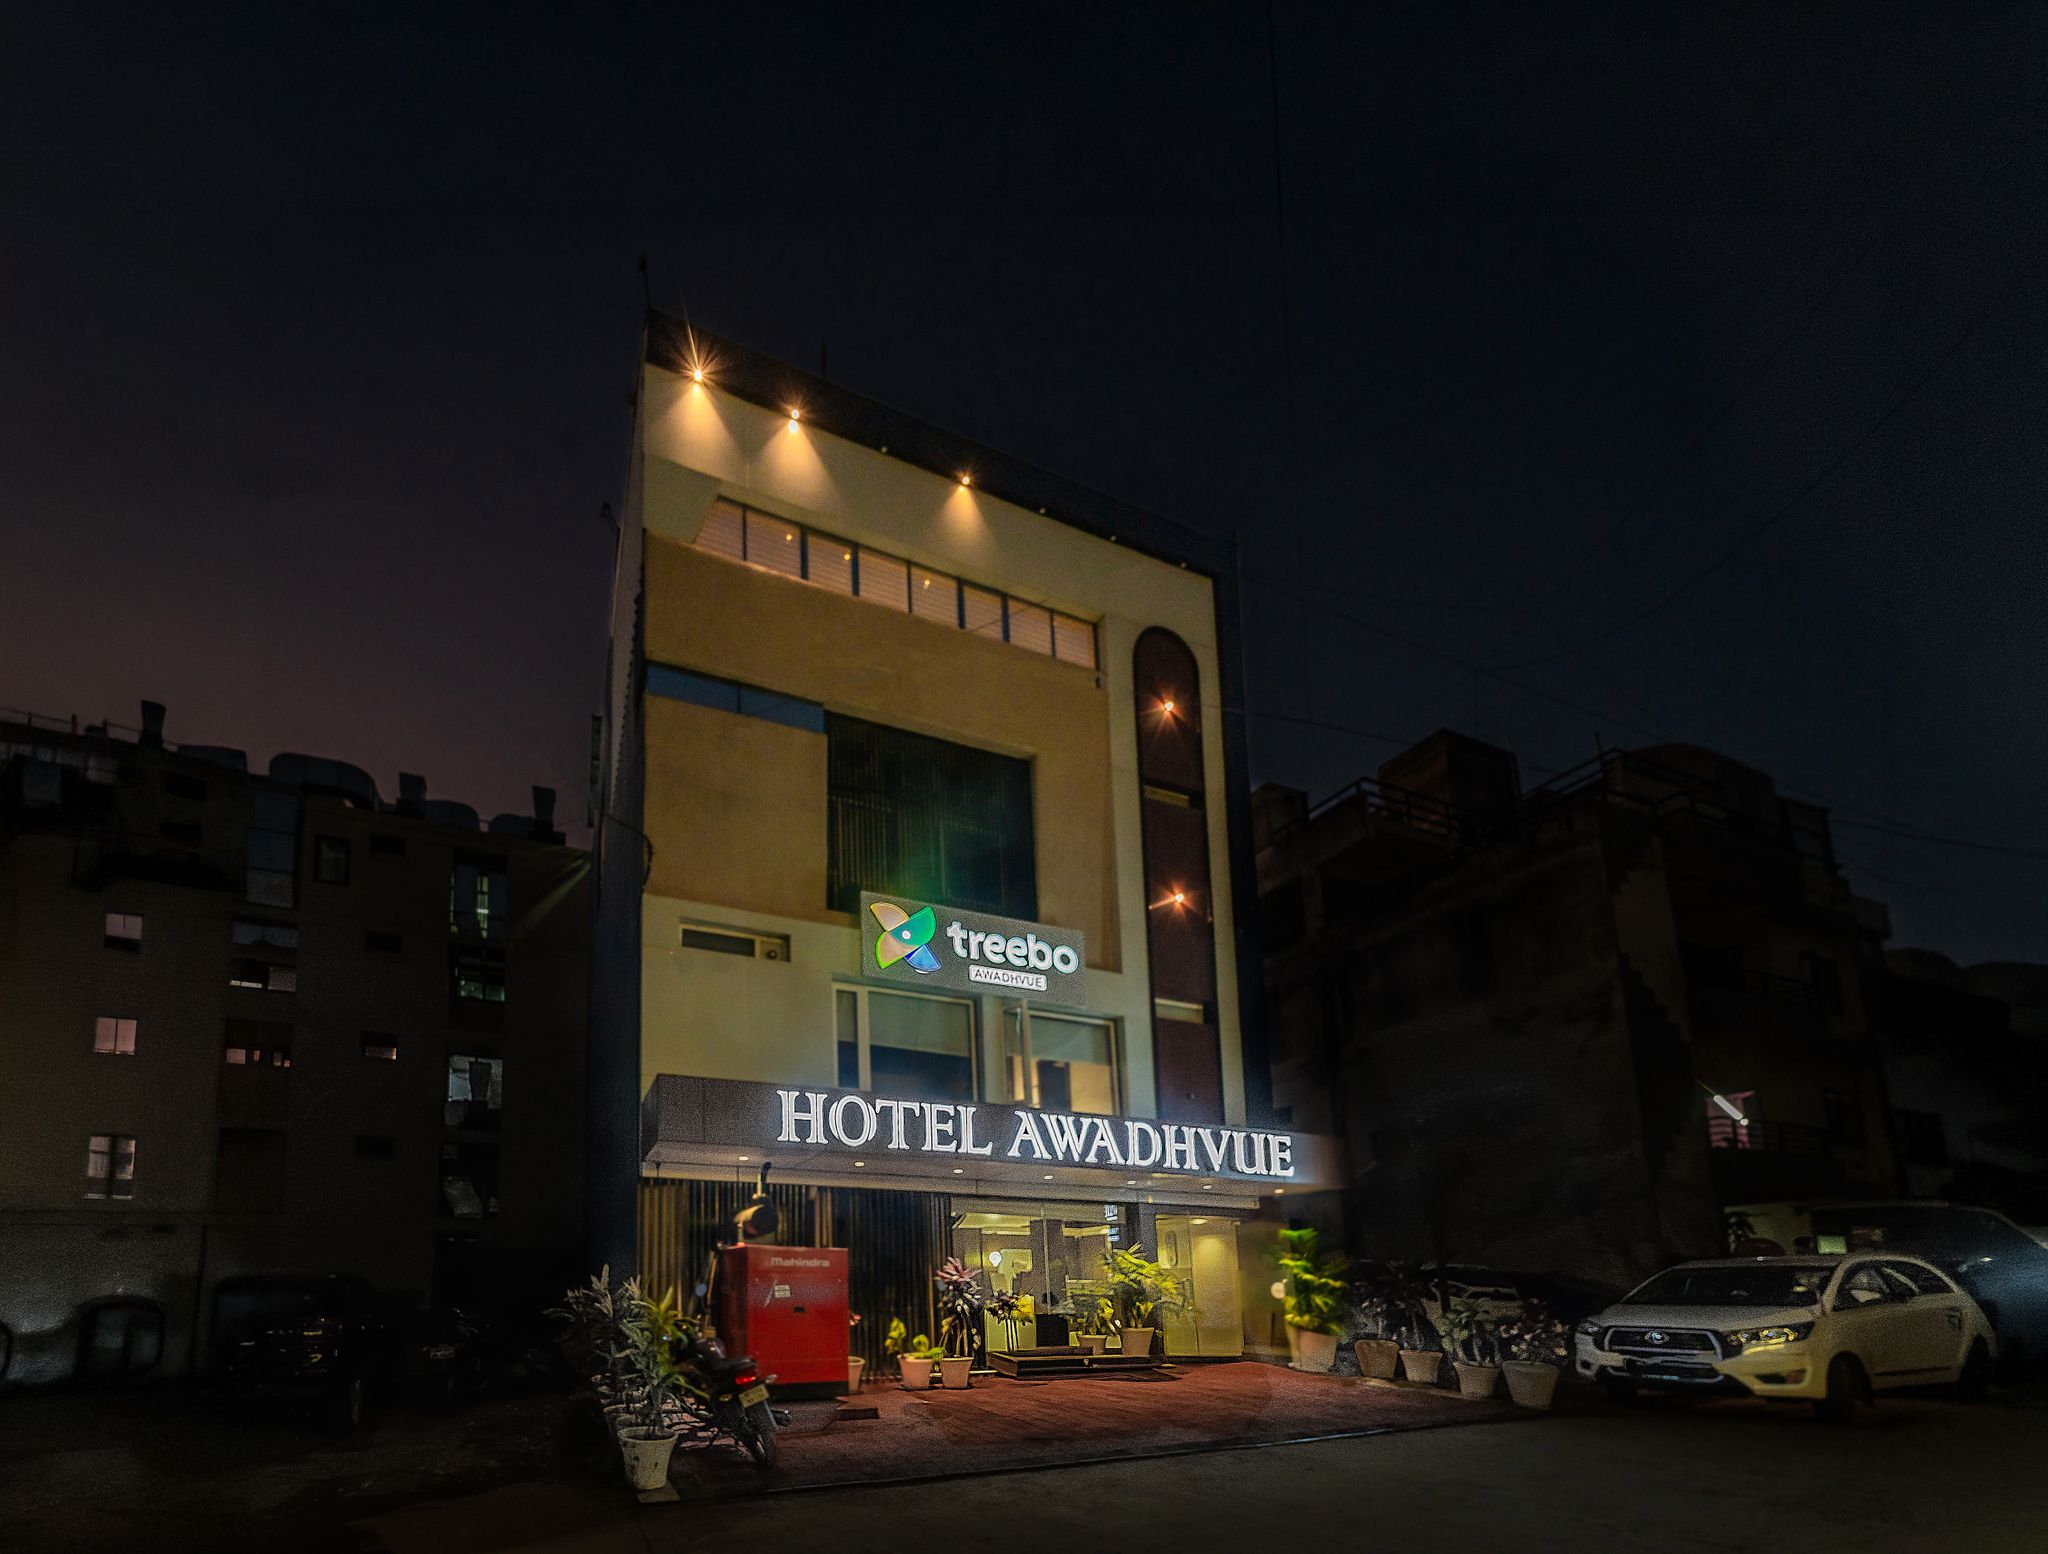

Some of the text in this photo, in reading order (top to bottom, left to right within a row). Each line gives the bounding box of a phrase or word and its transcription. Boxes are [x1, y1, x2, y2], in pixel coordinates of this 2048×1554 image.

[947, 921, 1079, 974] treebo
[974, 968, 1043, 988] AWADHVUE
[777, 1089, 1295, 1177] HOTEL AWADHVUE
